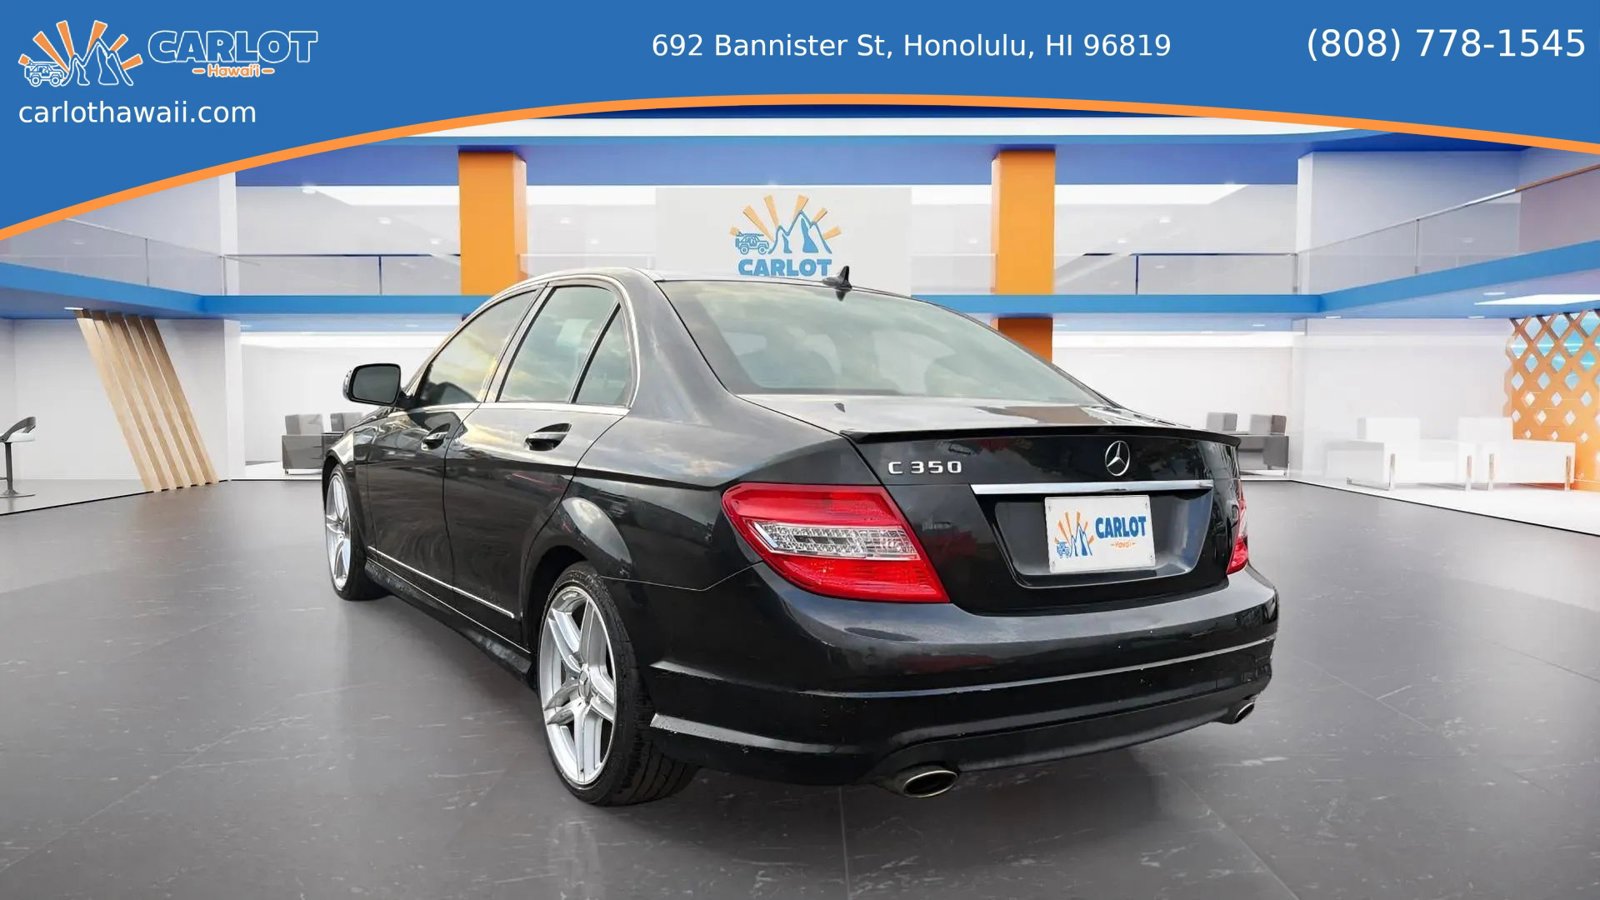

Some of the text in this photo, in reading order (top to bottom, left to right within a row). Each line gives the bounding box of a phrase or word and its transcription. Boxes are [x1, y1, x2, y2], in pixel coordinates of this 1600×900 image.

[738, 258, 832, 277] CARLOT
[888, 460, 962, 474] C 350
[1095, 516, 1147, 539] CARLOT
